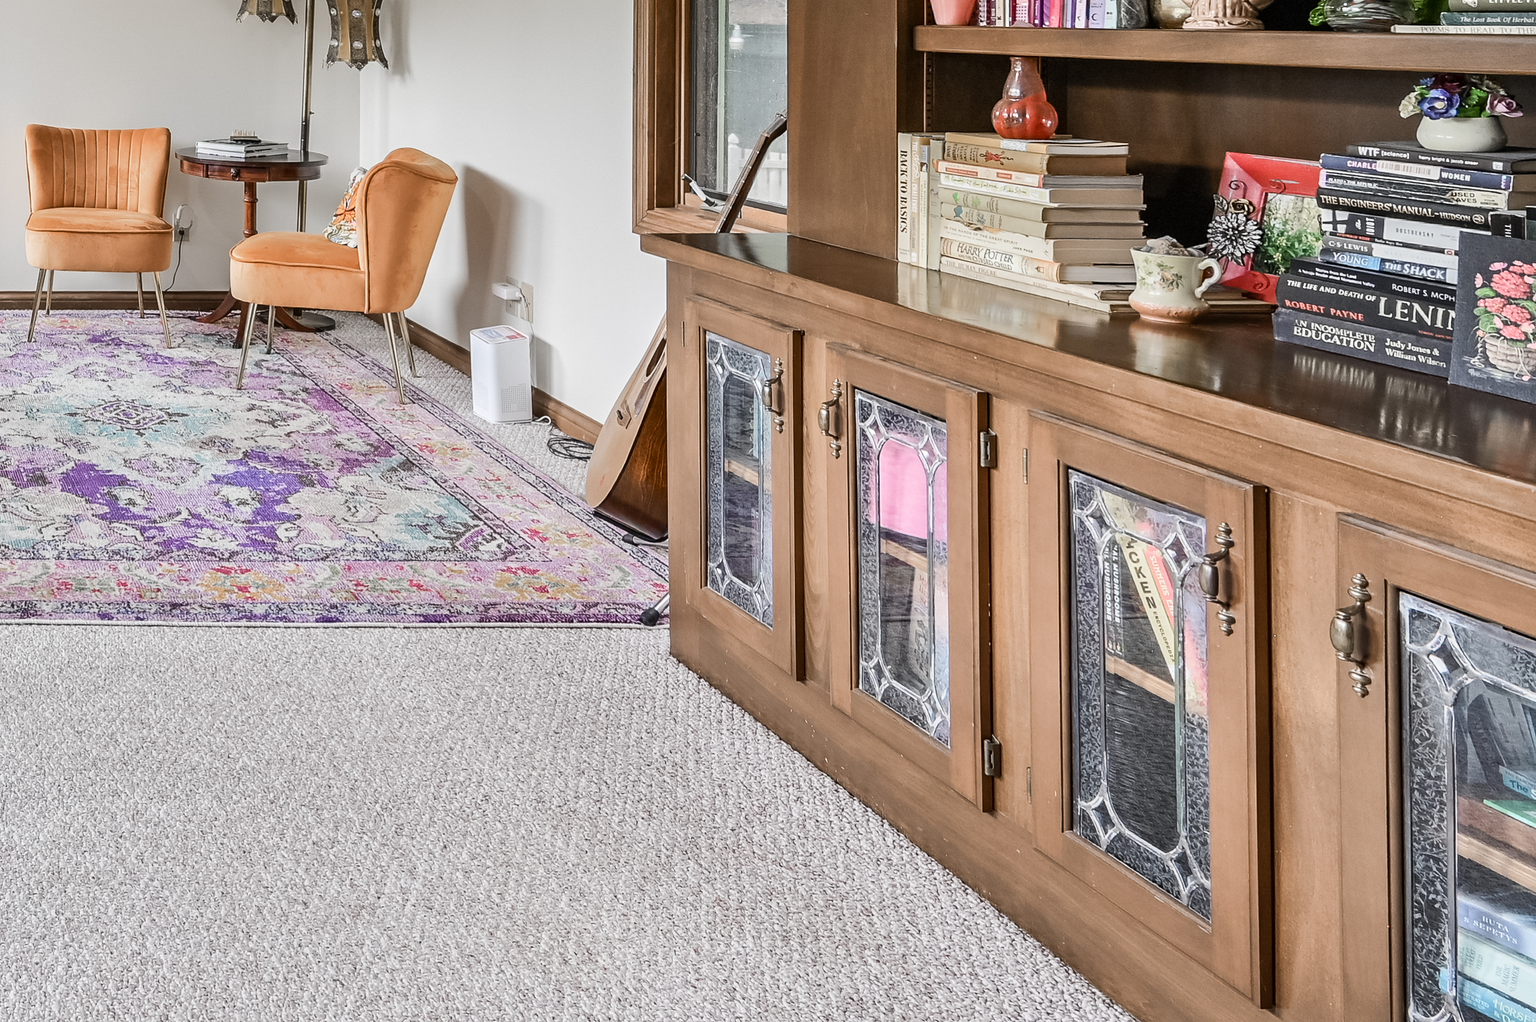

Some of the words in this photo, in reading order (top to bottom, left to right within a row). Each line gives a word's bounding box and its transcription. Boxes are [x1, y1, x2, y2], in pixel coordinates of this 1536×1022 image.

[1502, 16, 1511, 24] Of
[1358, 146, 1380, 157] WTF
[1381, 151, 1410, 161] [science]
[1418, 154, 1431, 162] harry
[900, 150, 908, 177] BACK
[1347, 160, 1377, 171] CHARLE
[900, 179, 908, 193] TO
[1441, 171, 1471, 182] WOMEN
[1320, 195, 1339, 206] THE
[1339, 196, 1391, 212] ENGINEERS'
[1451, 191, 1476, 199] USED
[900, 196, 908, 233] BASICS
[1366, 217, 1375, 236] IDIOT
[1396, 228, 1435, 238] DOSTOEVSKY
[957, 242, 984, 258] HARRY
[984, 248, 1014, 265] POTTER
[1344, 242, 1369, 253] LEWIS
[1332, 252, 1369, 266] YOUNG
[1385, 262, 1402, 271] THE
[1403, 264, 1446, 280] SHACK
[1287, 280, 1301, 289] THE
[1302, 282, 1318, 292] LIFE
[1319, 286, 1337, 296] AND
[1338, 288, 1364, 300] DEATH
[1366, 294, 1377, 303] OF
[1392, 284, 1421, 296] ROBERT
[1422, 289, 1429, 297] S.
[1431, 291, 1456, 303] MCPH
[1284, 299, 1326, 314] ROBERT
[1330, 308, 1365, 322] PAYNE
[1294, 319, 1308, 329] AN
[1311, 321, 1376, 343] INCOMPLETE
[1294, 327, 1376, 354] EDUCATION
[1385, 338, 1406, 350] Judy
[1406, 344, 1431, 356] Jones
[1432, 348, 1440, 357] &
[1386, 347, 1417, 363] William
[1418, 354, 1447, 369] Wilson
[1150, 555, 1170, 597] SUMMERS
[1104, 562, 1112, 622] MUSHROOMS
[1112, 562, 1121, 624] MUSHROOMS
[1152, 611, 1176, 663] ENCYCLOPEDIA
[1510, 780, 1529, 794] The
[1473, 920, 1518, 945] SEPETYS
[1482, 916, 1510, 933] RUTA
